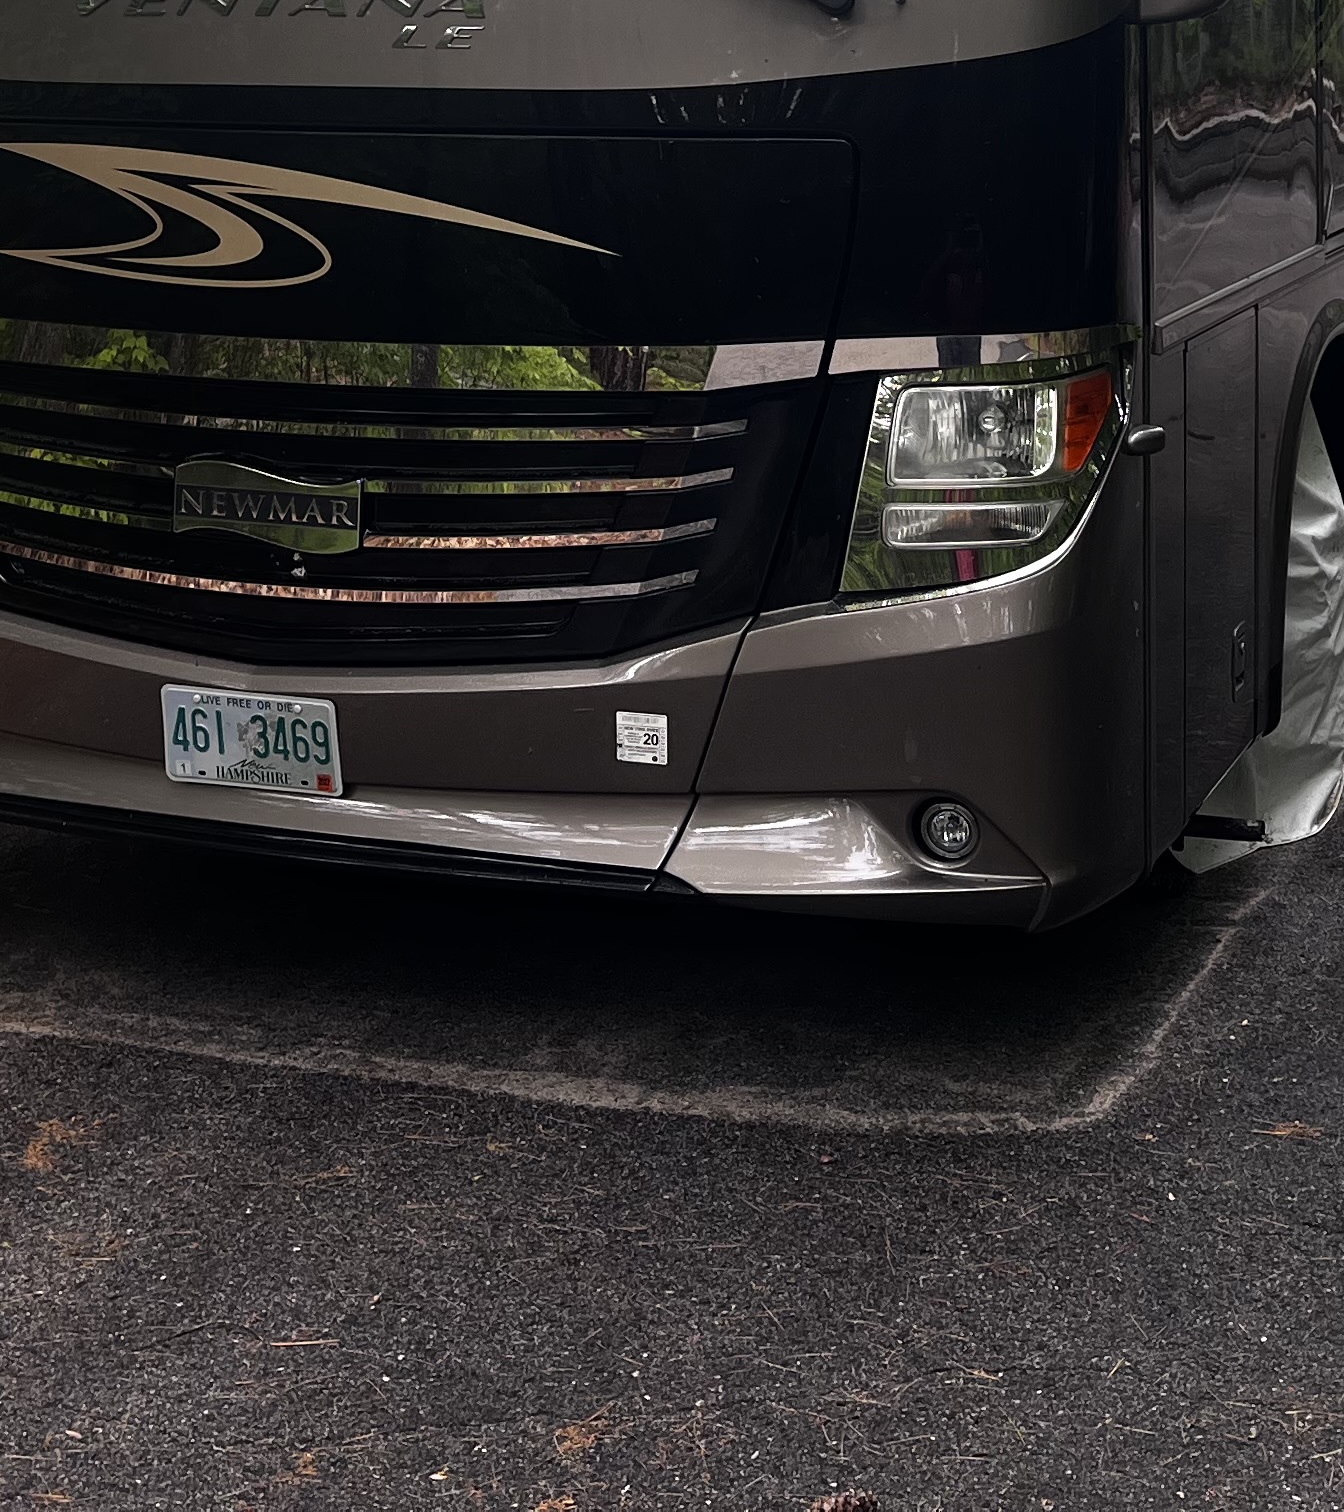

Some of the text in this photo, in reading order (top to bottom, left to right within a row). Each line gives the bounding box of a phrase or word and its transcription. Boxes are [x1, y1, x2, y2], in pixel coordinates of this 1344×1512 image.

[392, 24, 486, 51] LE
[177, 488, 356, 528] NEWMAR
[201, 695, 294, 713] LIVE FREE OR DIE
[172, 706, 331, 765] 461 3469
[643, 733, 659, 746] 20
[215, 765, 293, 785] HAMPSHIRE
